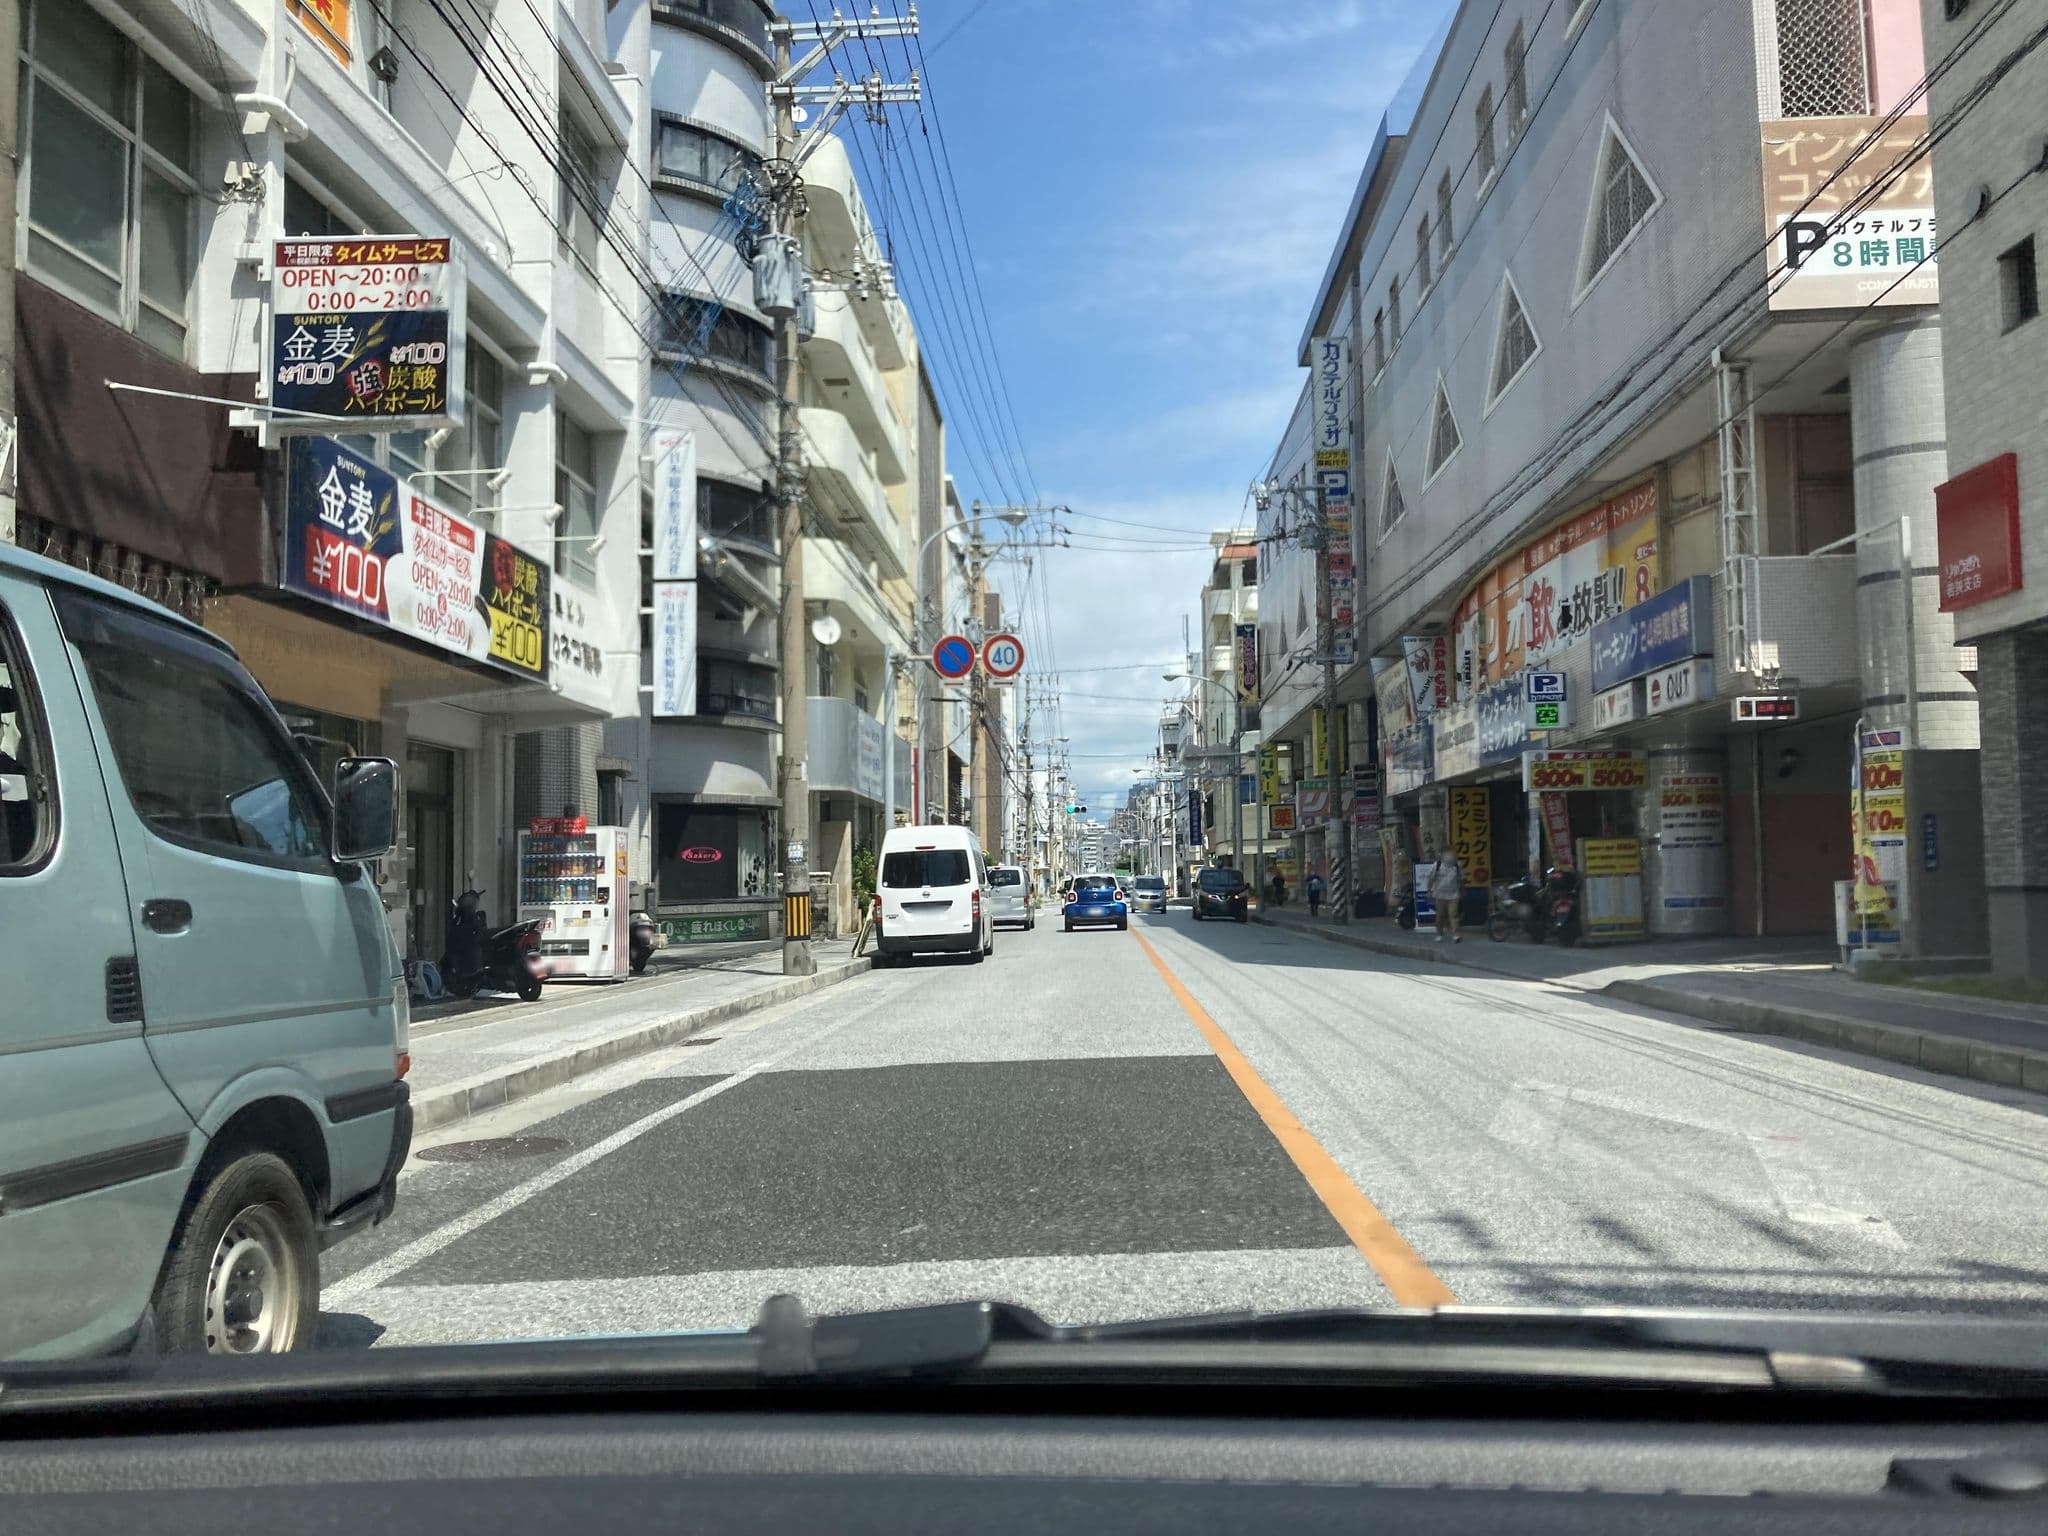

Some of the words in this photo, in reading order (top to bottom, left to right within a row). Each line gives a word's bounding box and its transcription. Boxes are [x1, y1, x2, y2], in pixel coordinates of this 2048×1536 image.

[284, 245, 333, 257] 平日限定
[336, 244, 445, 262] タイムサービス
[1785, 221, 1828, 270] P
[293, 315, 348, 326] SUNTORY
[282, 325, 355, 362] 金麦
[389, 342, 445, 364] ¥100
[277, 361, 335, 385] ¥100
[344, 392, 443, 413] ハイボール
[318, 465, 373, 543] 金麦
[312, 538, 382, 607] ¥100
[495, 619, 538, 667] ¥100
[992, 646, 1015, 666] 40
[1535, 675, 1557, 692] P
[1666, 668, 1690, 703] OUT
